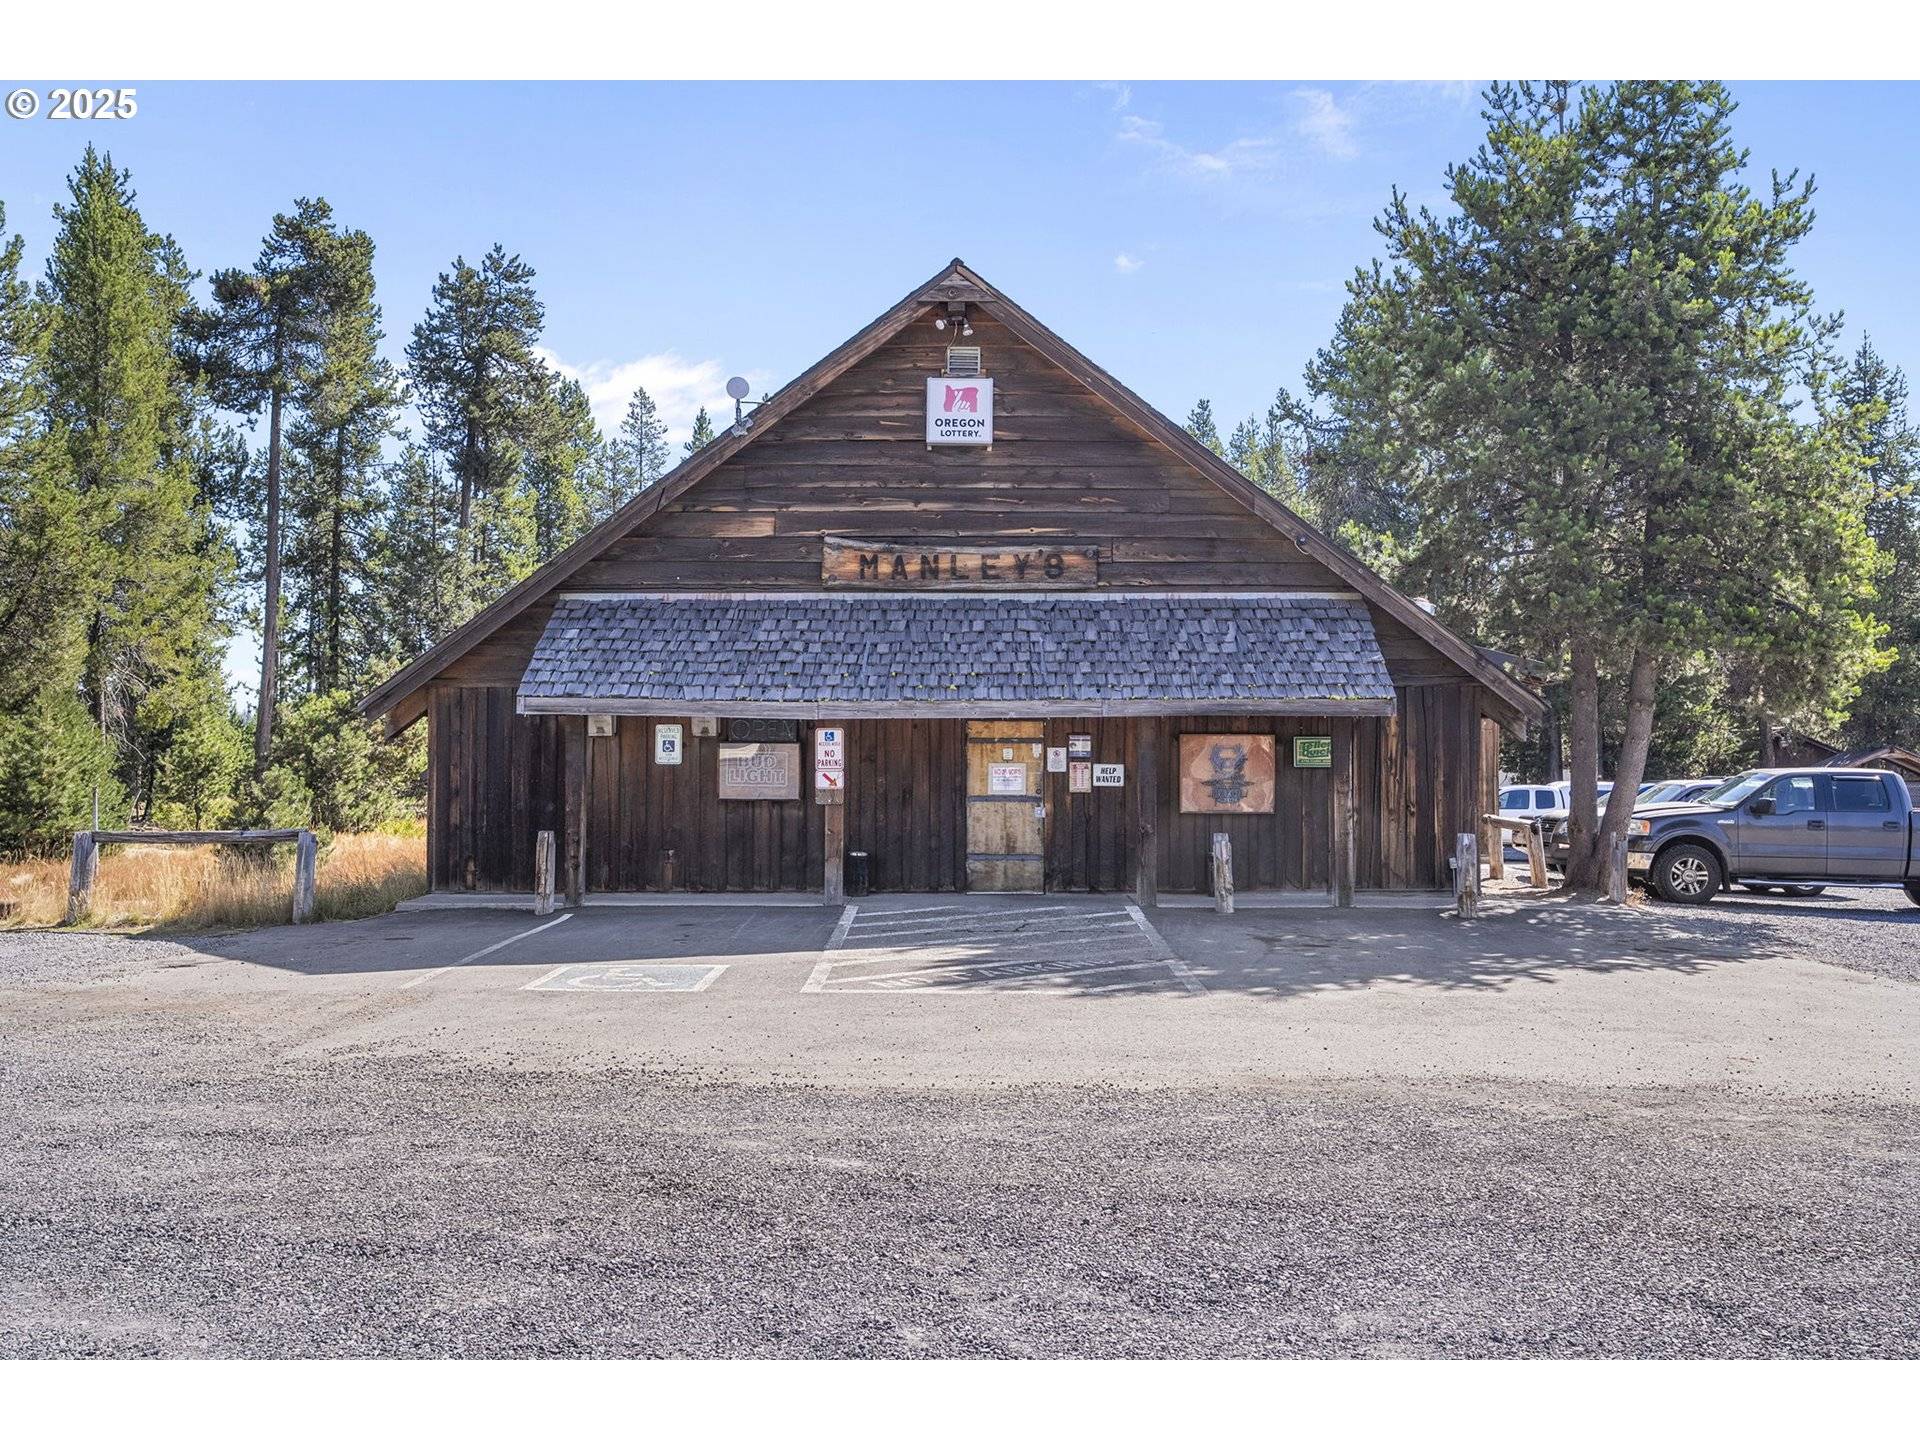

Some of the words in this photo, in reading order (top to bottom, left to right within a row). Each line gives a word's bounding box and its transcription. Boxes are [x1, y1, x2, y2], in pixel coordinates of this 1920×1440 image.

[934, 418, 985, 428] OREGON
[859, 550, 1065, 580] MANLEY'S
[730, 719, 796, 739] OPEN
[736, 754, 776, 769] BUD
[817, 759, 842, 767] PARKING
[728, 768, 784, 784] LIGHT
[1101, 767, 1117, 775] HELP
[1095, 775, 1122, 783] WANTED
